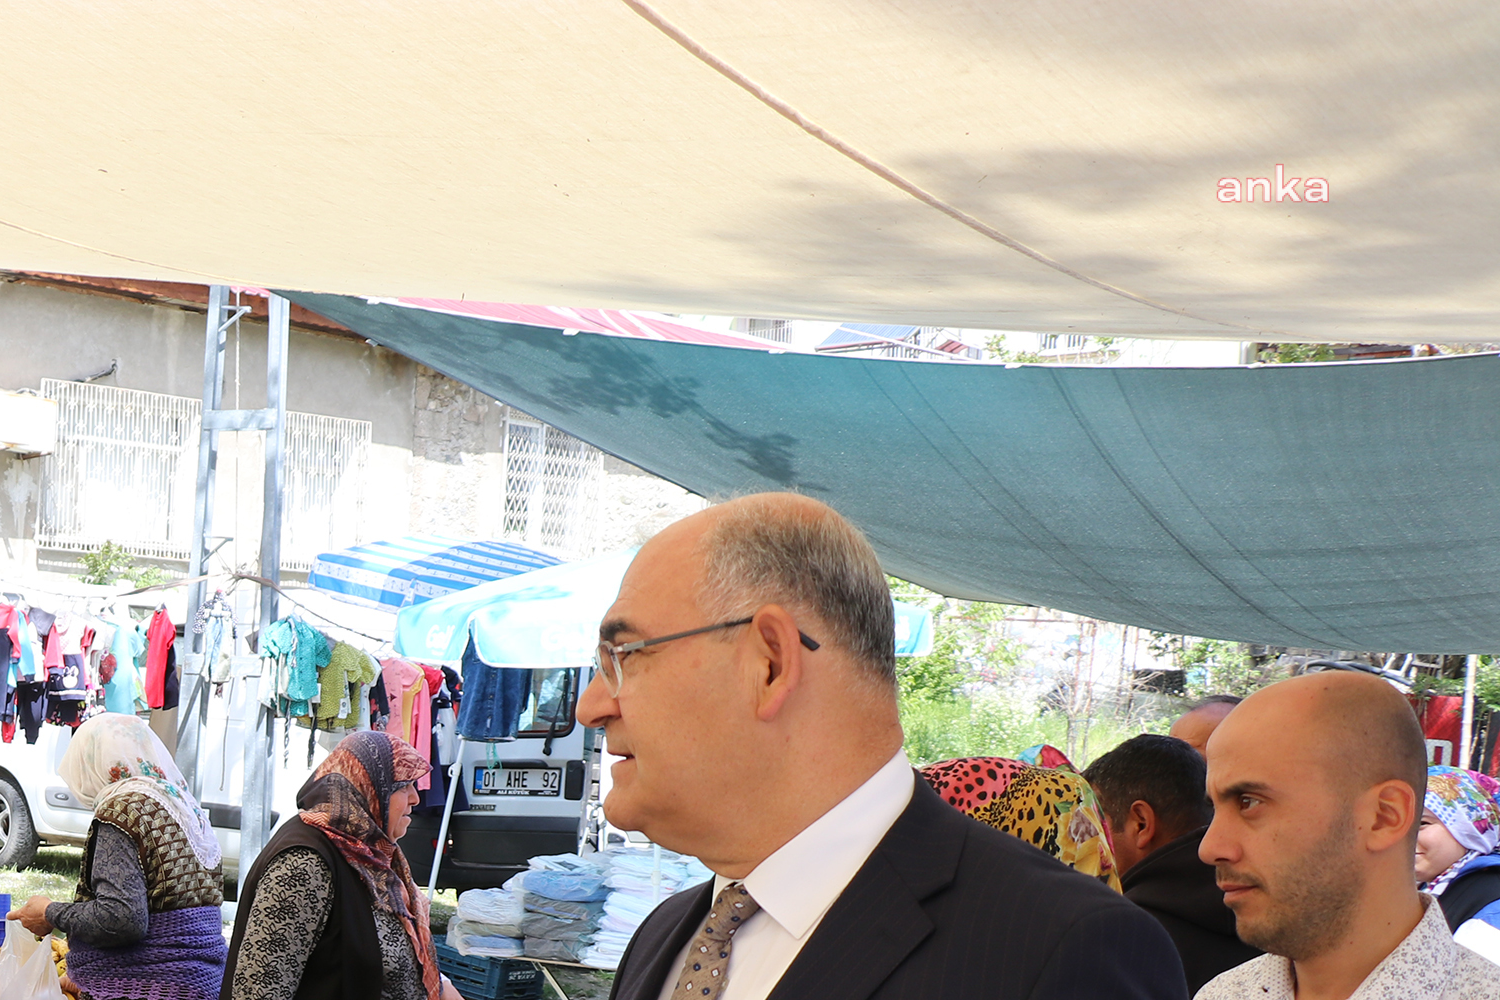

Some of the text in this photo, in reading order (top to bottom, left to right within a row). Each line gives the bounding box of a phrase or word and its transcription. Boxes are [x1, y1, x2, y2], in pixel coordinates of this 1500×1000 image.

[483, 771, 557, 788] 01 AHE 92
